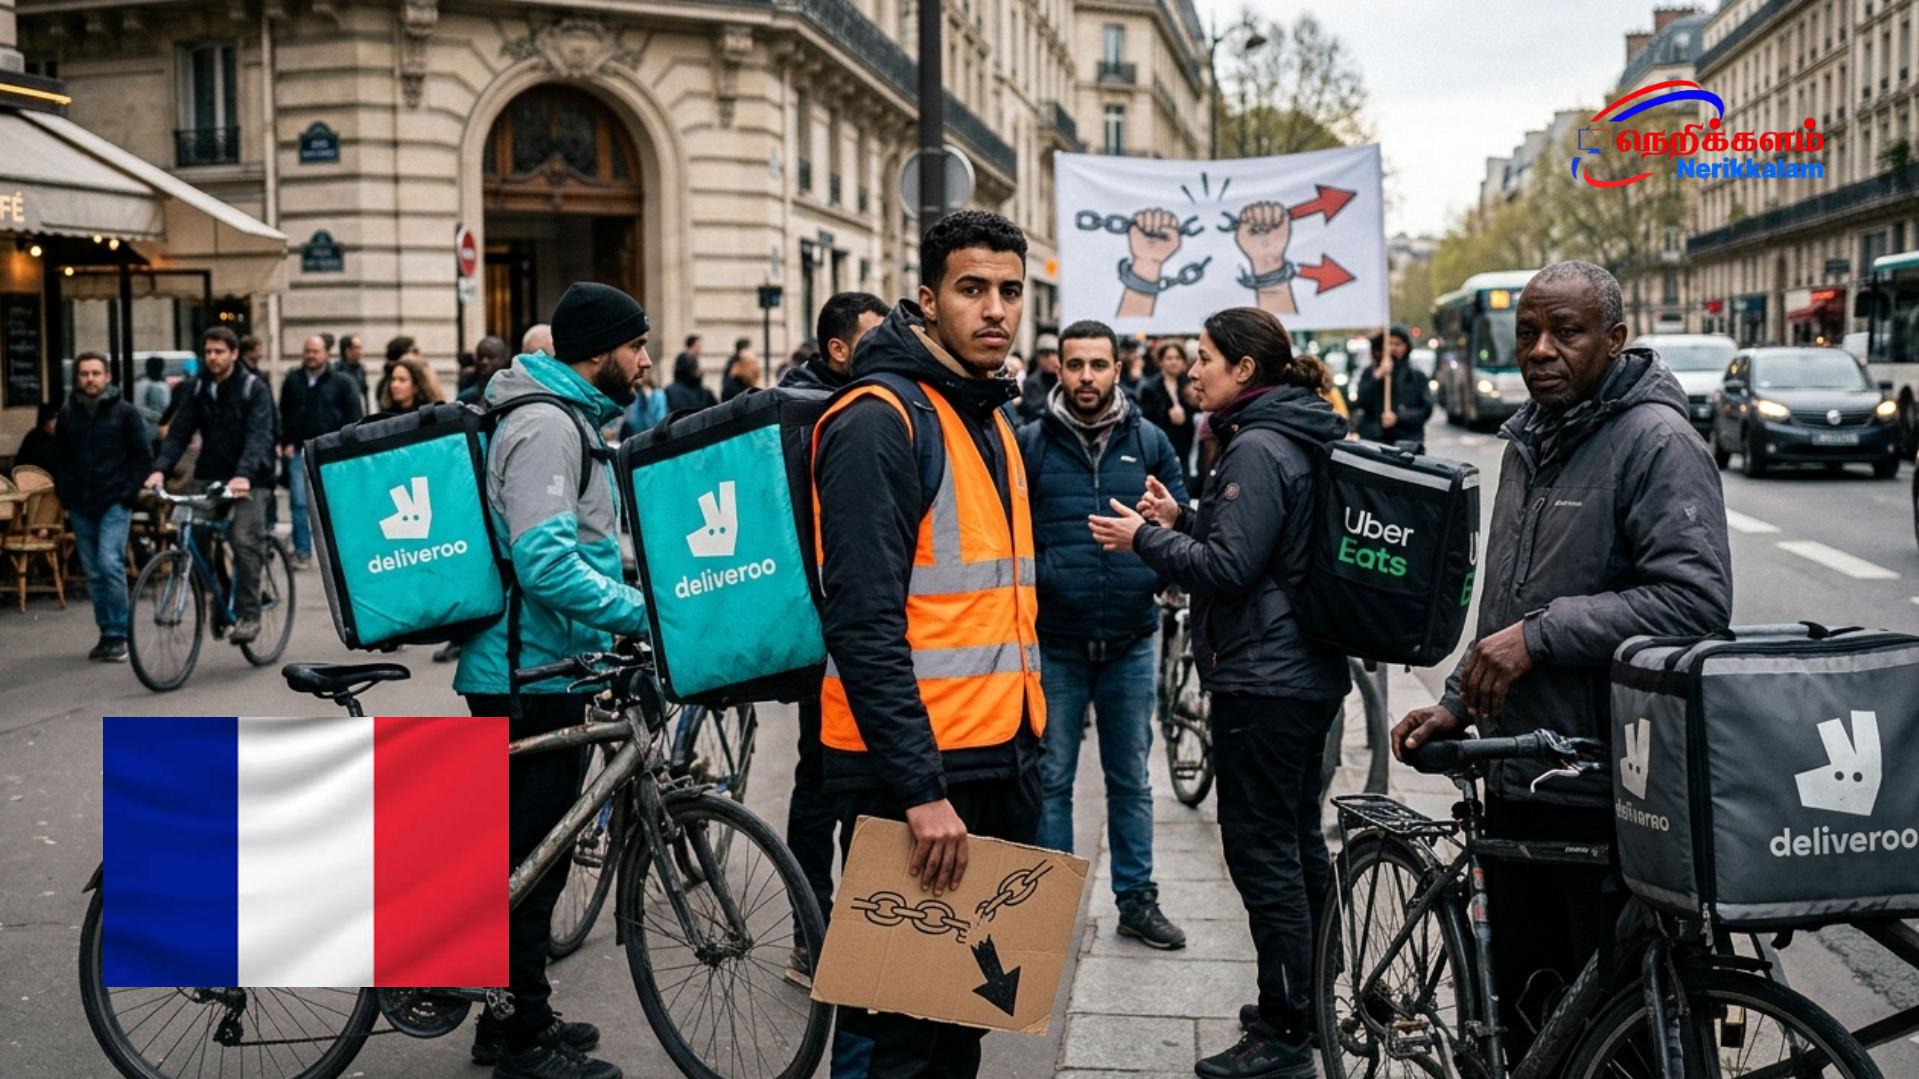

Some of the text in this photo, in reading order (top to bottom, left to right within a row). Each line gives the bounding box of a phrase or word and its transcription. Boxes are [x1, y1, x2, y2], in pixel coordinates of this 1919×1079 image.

[1345, 507, 1414, 546] Uber
[367, 539, 468, 574] deliveroo
[1338, 536, 1407, 576] Eats
[674, 557, 777, 599] deliveroo
[1770, 826, 1918, 857] deliveroo
